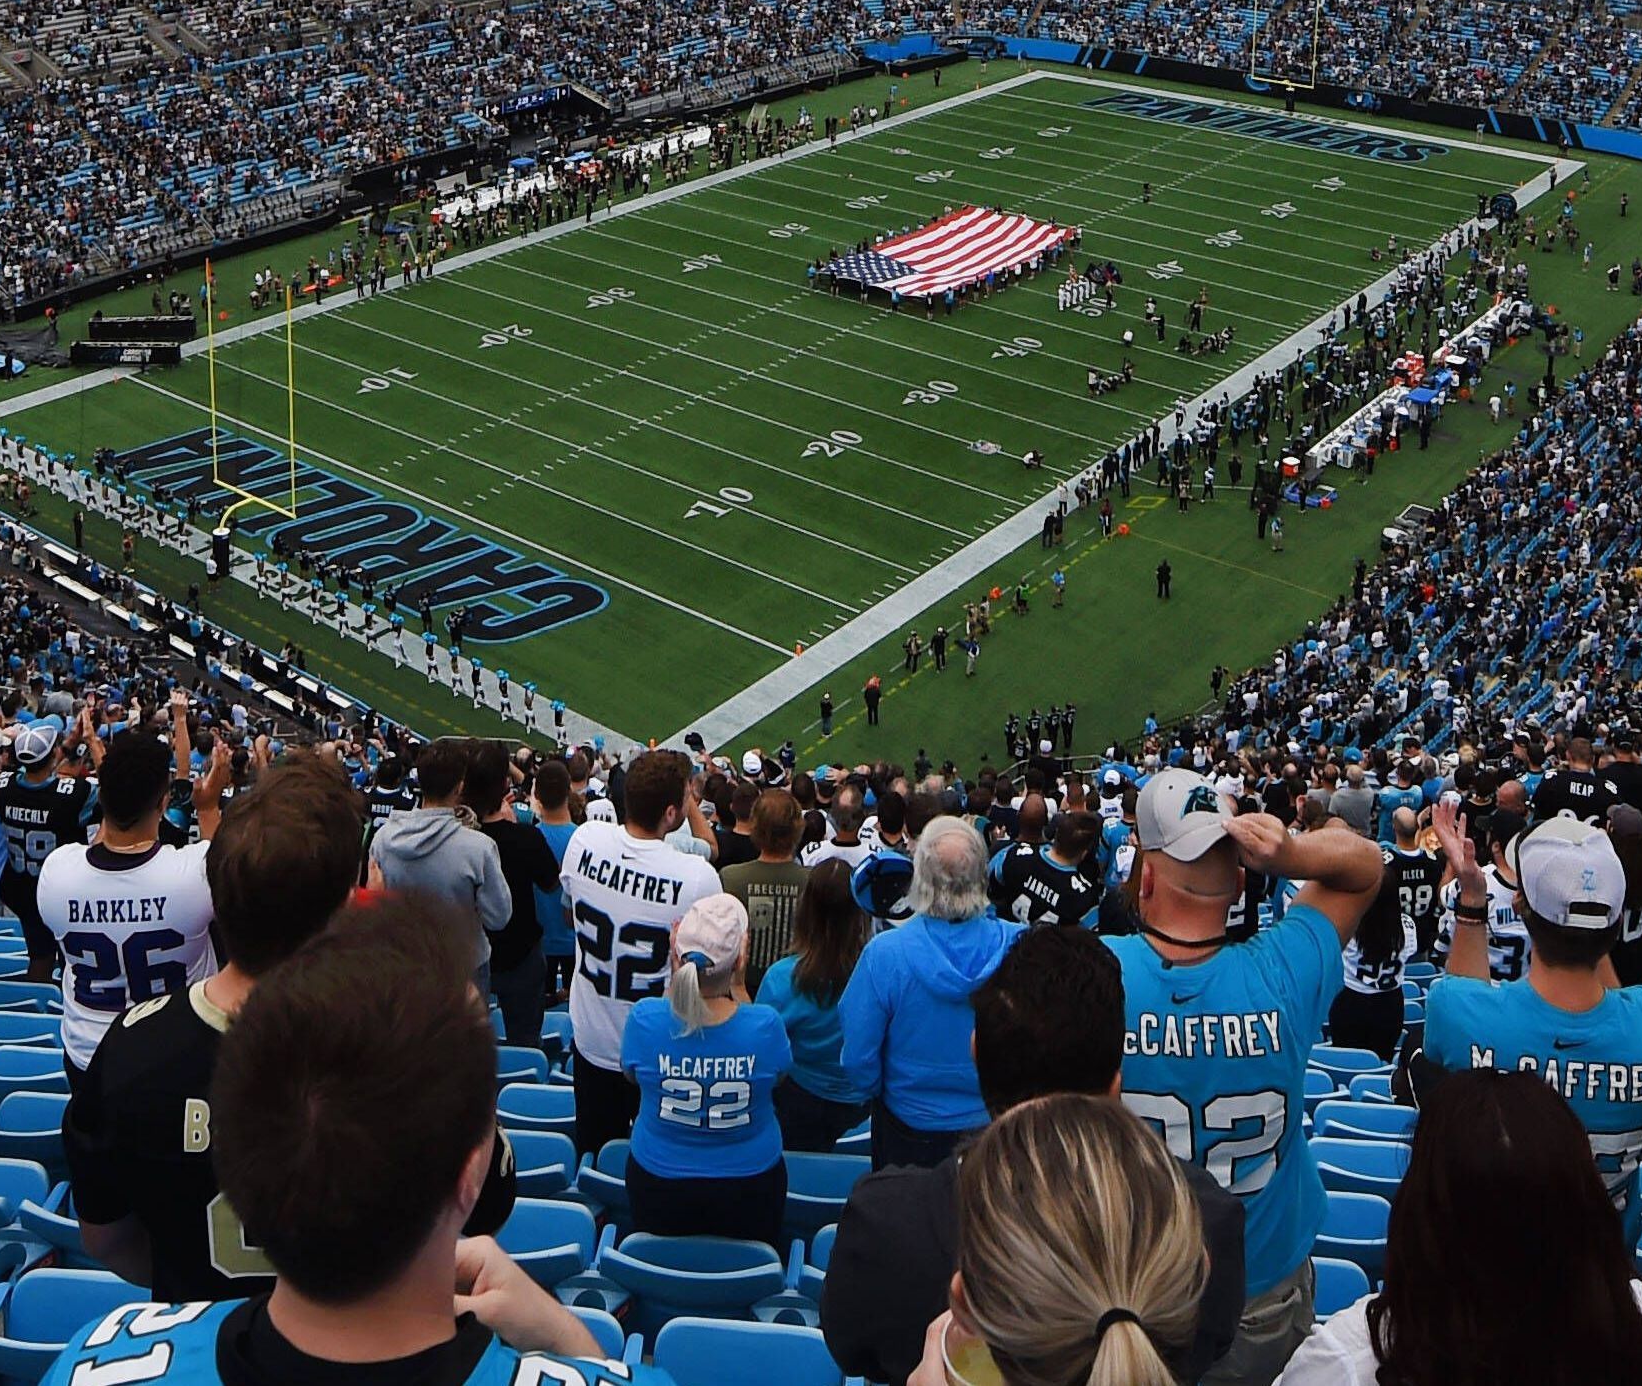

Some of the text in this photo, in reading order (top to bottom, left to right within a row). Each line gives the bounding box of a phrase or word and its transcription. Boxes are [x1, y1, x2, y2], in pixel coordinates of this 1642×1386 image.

[1080, 91, 1450, 165] PANTHERS
[809, 429, 863, 459] 20
[698, 485, 754, 519] 10
[111, 426, 610, 645] CAROLINA
[5, 805, 50, 825] KUECHLY
[5, 826, 59, 878] 59
[576, 848, 683, 907] McCAFFREY
[747, 883, 799, 897] FREEDOM
[1398, 883, 1434, 917] 88
[67, 896, 167, 924] BARKLEY
[62, 927, 188, 1013] 26
[573, 897, 671, 1003] 22
[1123, 1010, 1282, 1059] cCAFFREY
[658, 1053, 755, 1080] McCAFFREY
[659, 1078, 751, 1130] 22
